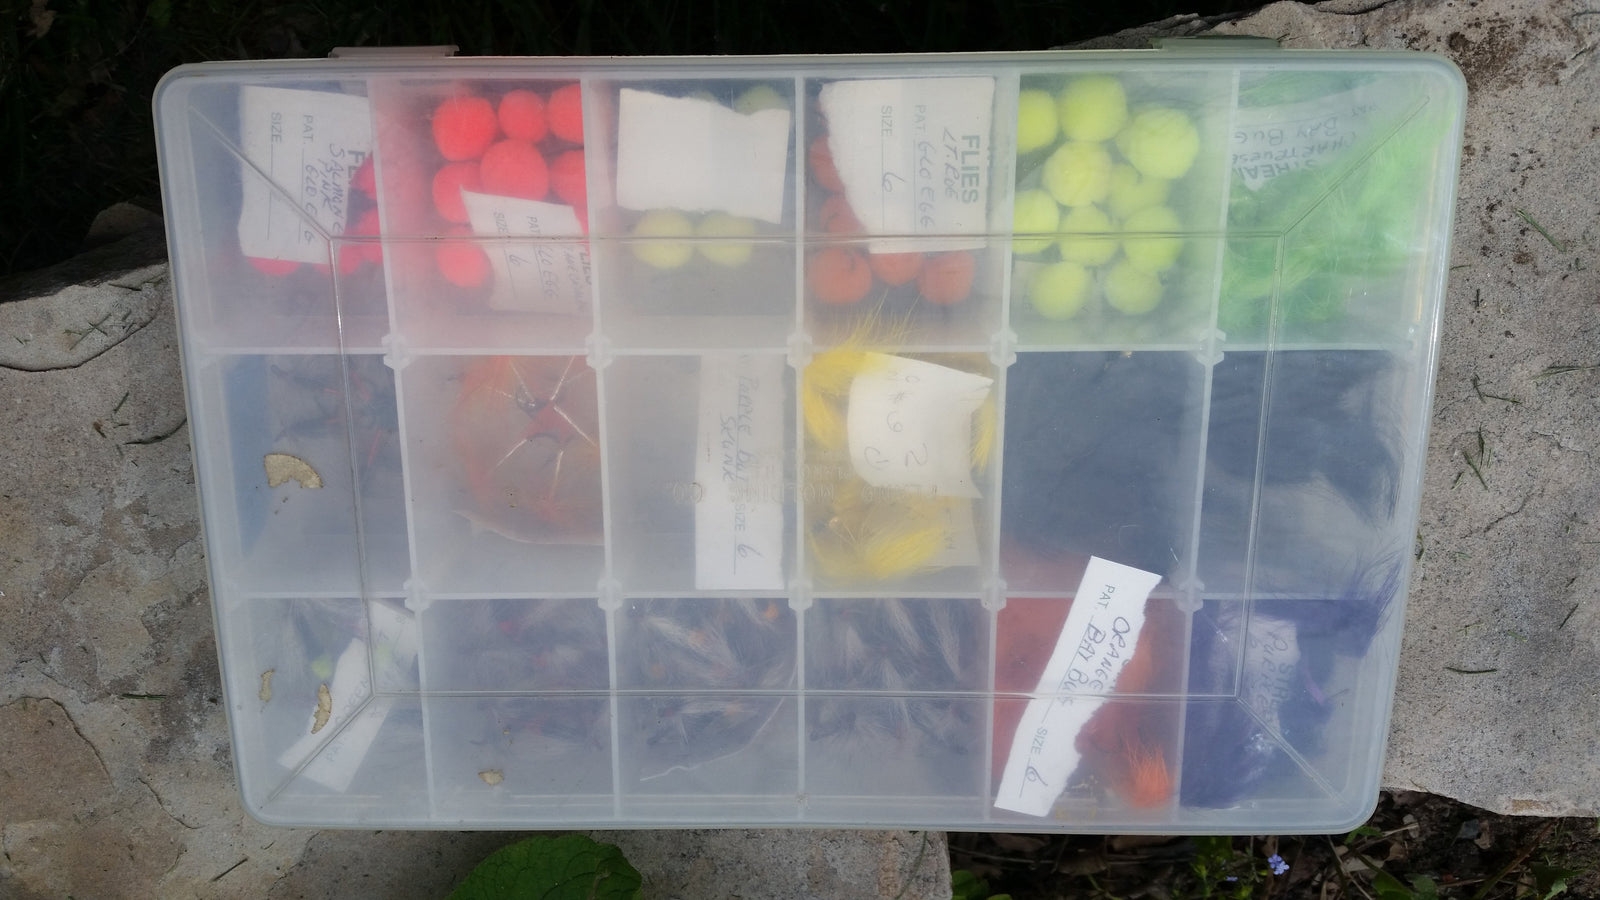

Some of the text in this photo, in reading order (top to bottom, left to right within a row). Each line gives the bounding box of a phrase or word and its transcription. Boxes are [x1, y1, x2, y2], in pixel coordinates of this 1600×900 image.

[271, 112, 283, 143] SIZE
[881, 105, 893, 136] SIZE
[882, 172, 907, 192] 6
[961, 134, 980, 204] FLIES
[493, 211, 508, 234] SIZE
[735, 503, 746, 532] SIZE
[736, 542, 764, 559] 6
[1077, 623, 1107, 662] BAY
[1088, 616, 1131, 692] ORANGE
[1030, 727, 1048, 755] SIZE
[1025, 765, 1049, 787] 6
